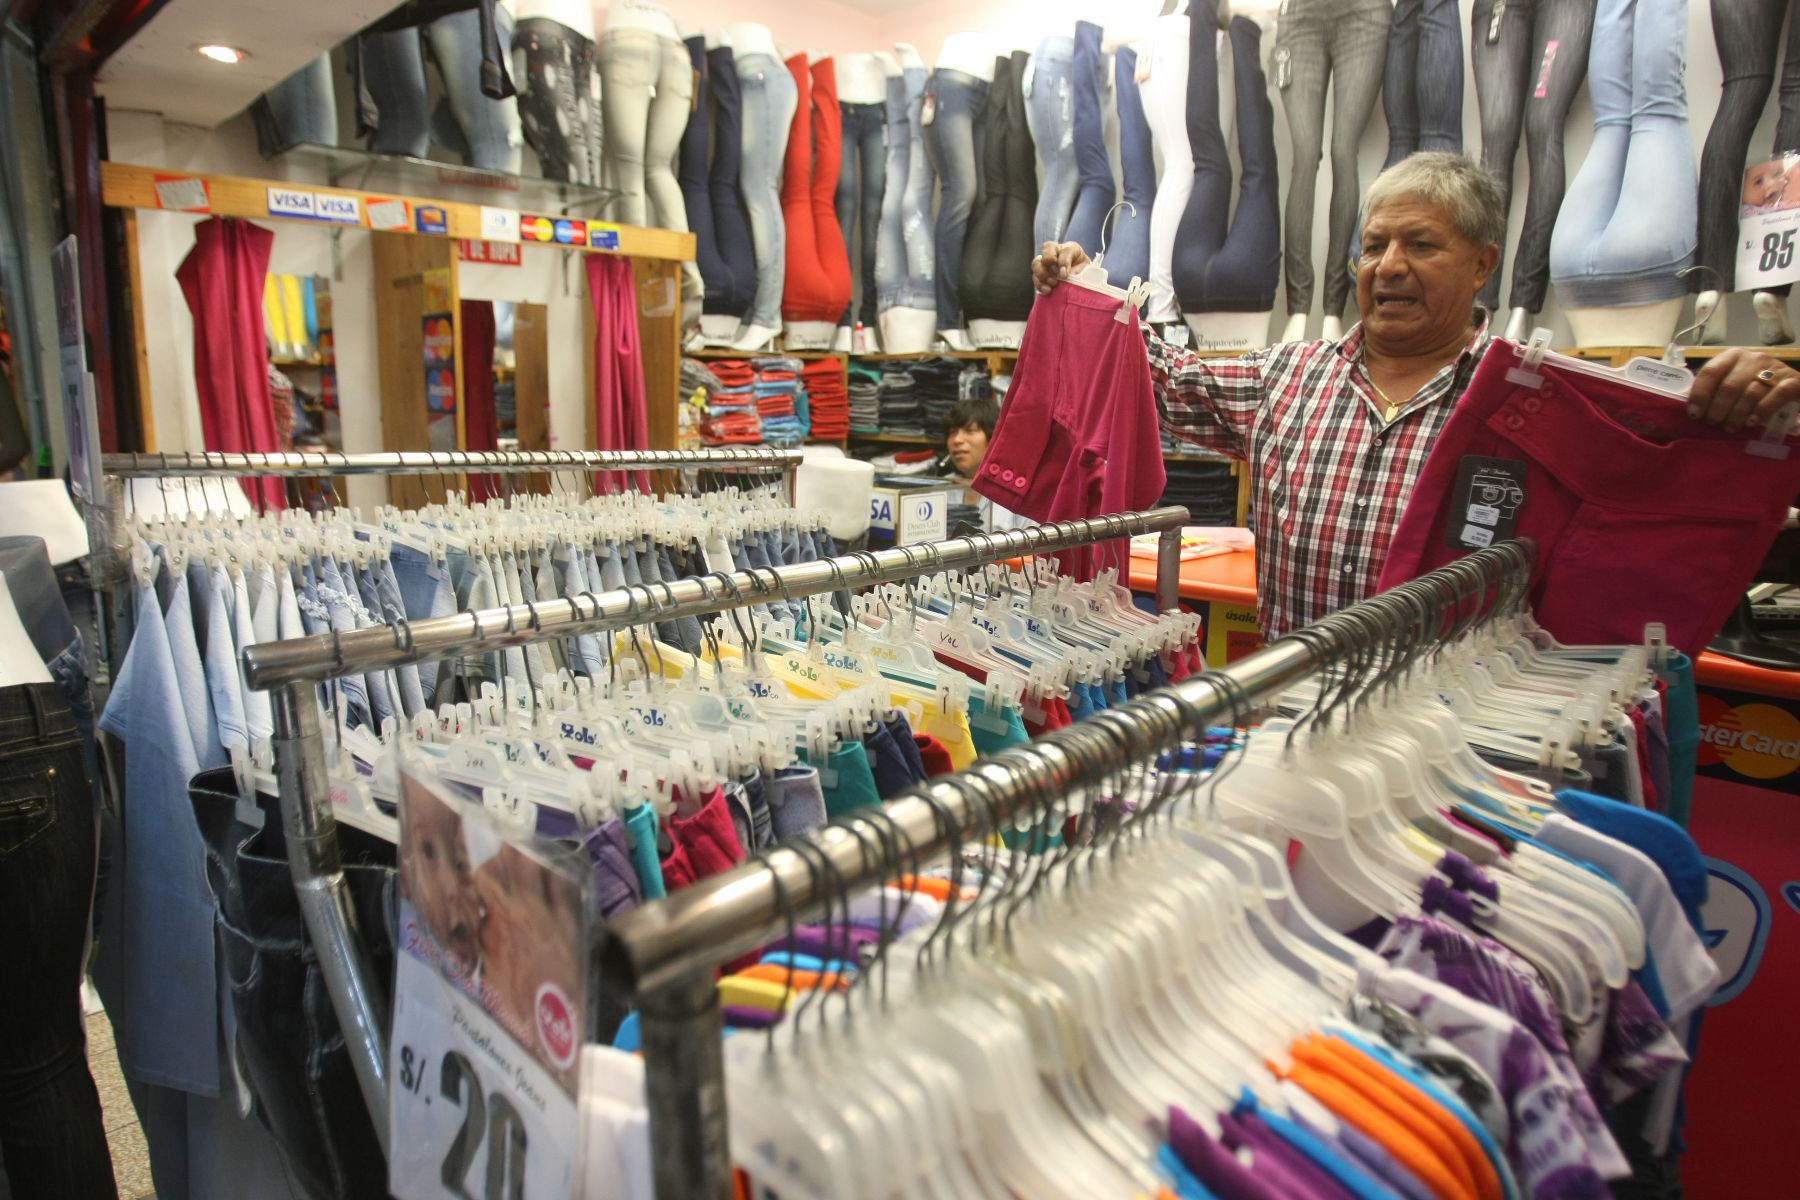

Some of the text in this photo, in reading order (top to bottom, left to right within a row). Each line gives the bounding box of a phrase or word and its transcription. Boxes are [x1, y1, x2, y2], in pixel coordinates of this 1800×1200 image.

[273, 192, 310, 209] VISA
[320, 198, 355, 215] VISA
[1759, 227, 1798, 272] 85
[1197, 334, 1248, 351] Cappuccino
[870, 499, 892, 522] SA
[1225, 609, 1257, 624] úsala
[1699, 723, 1800, 760] sterCard
[400, 1044, 528, 1200] S/. 20
